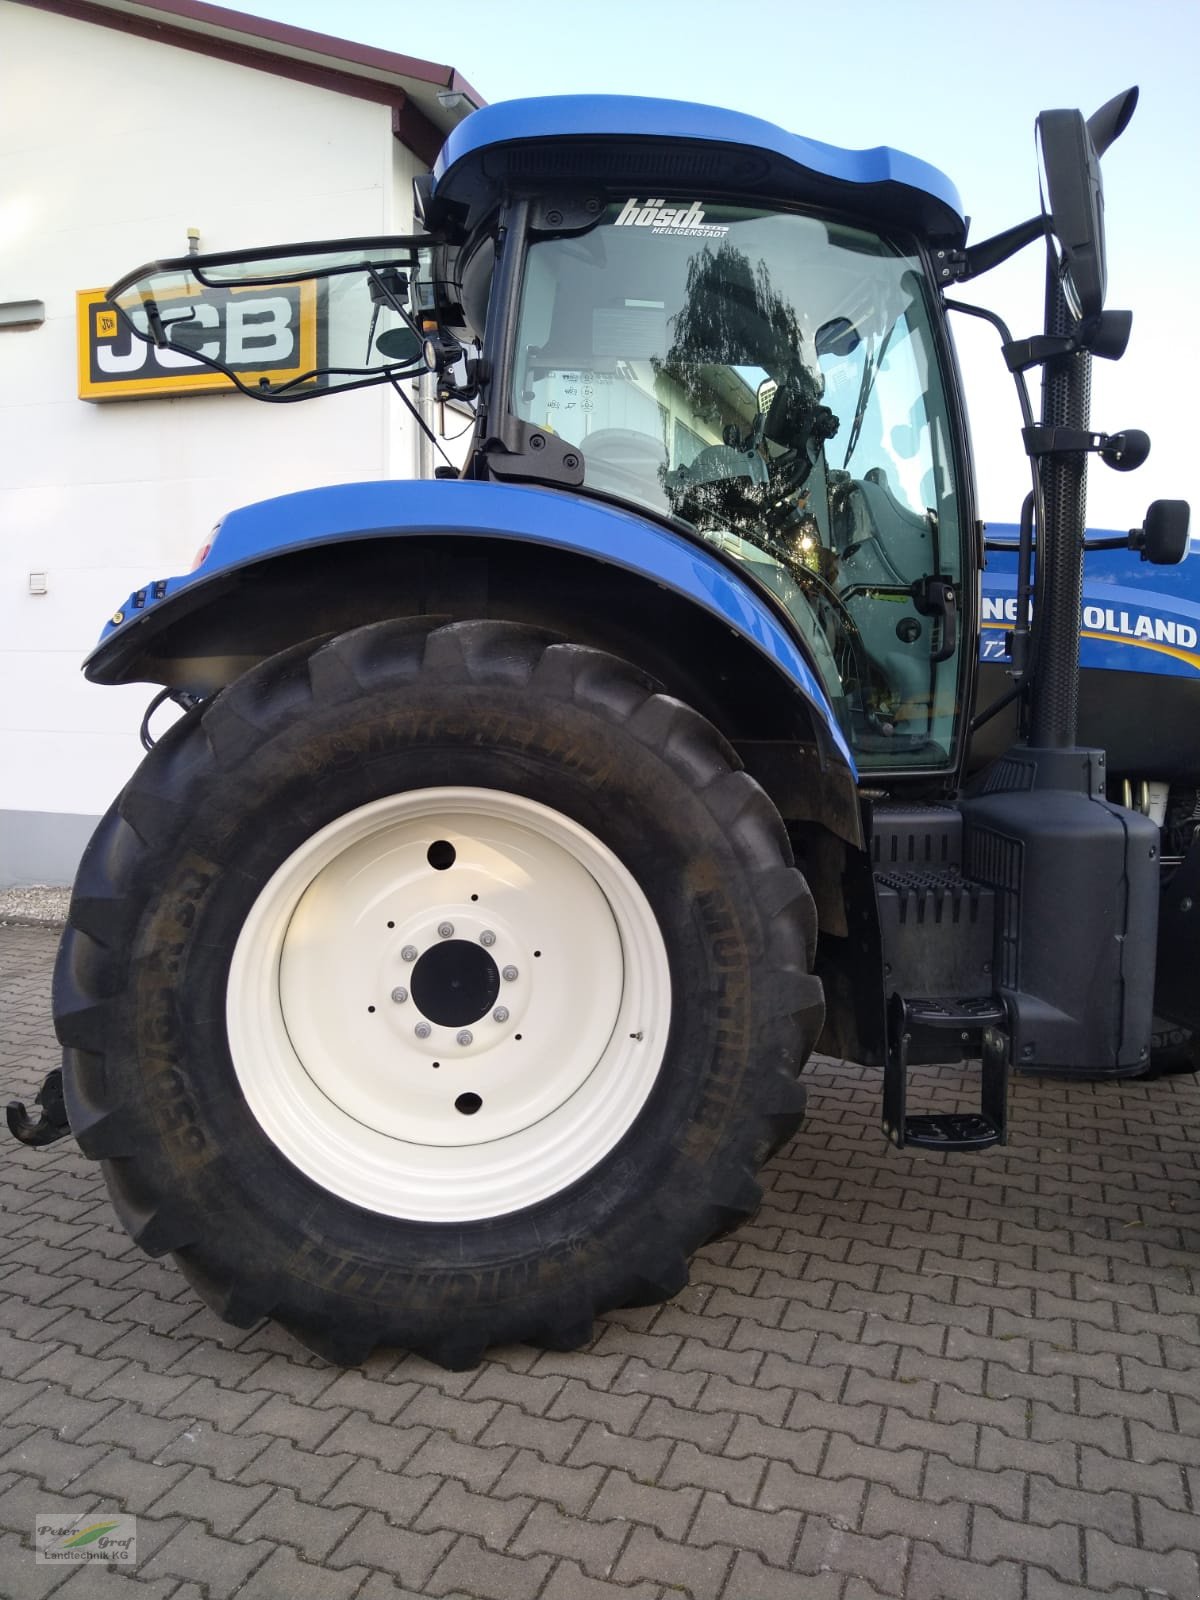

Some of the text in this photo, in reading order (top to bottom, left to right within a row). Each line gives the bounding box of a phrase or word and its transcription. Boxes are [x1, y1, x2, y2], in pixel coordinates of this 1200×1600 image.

[614, 198, 705, 229] hösch
[652, 227, 727, 238] HEILIGENSTADT
[97, 297, 294, 373] JCB
[1081, 606, 1197, 648] OLLAND
